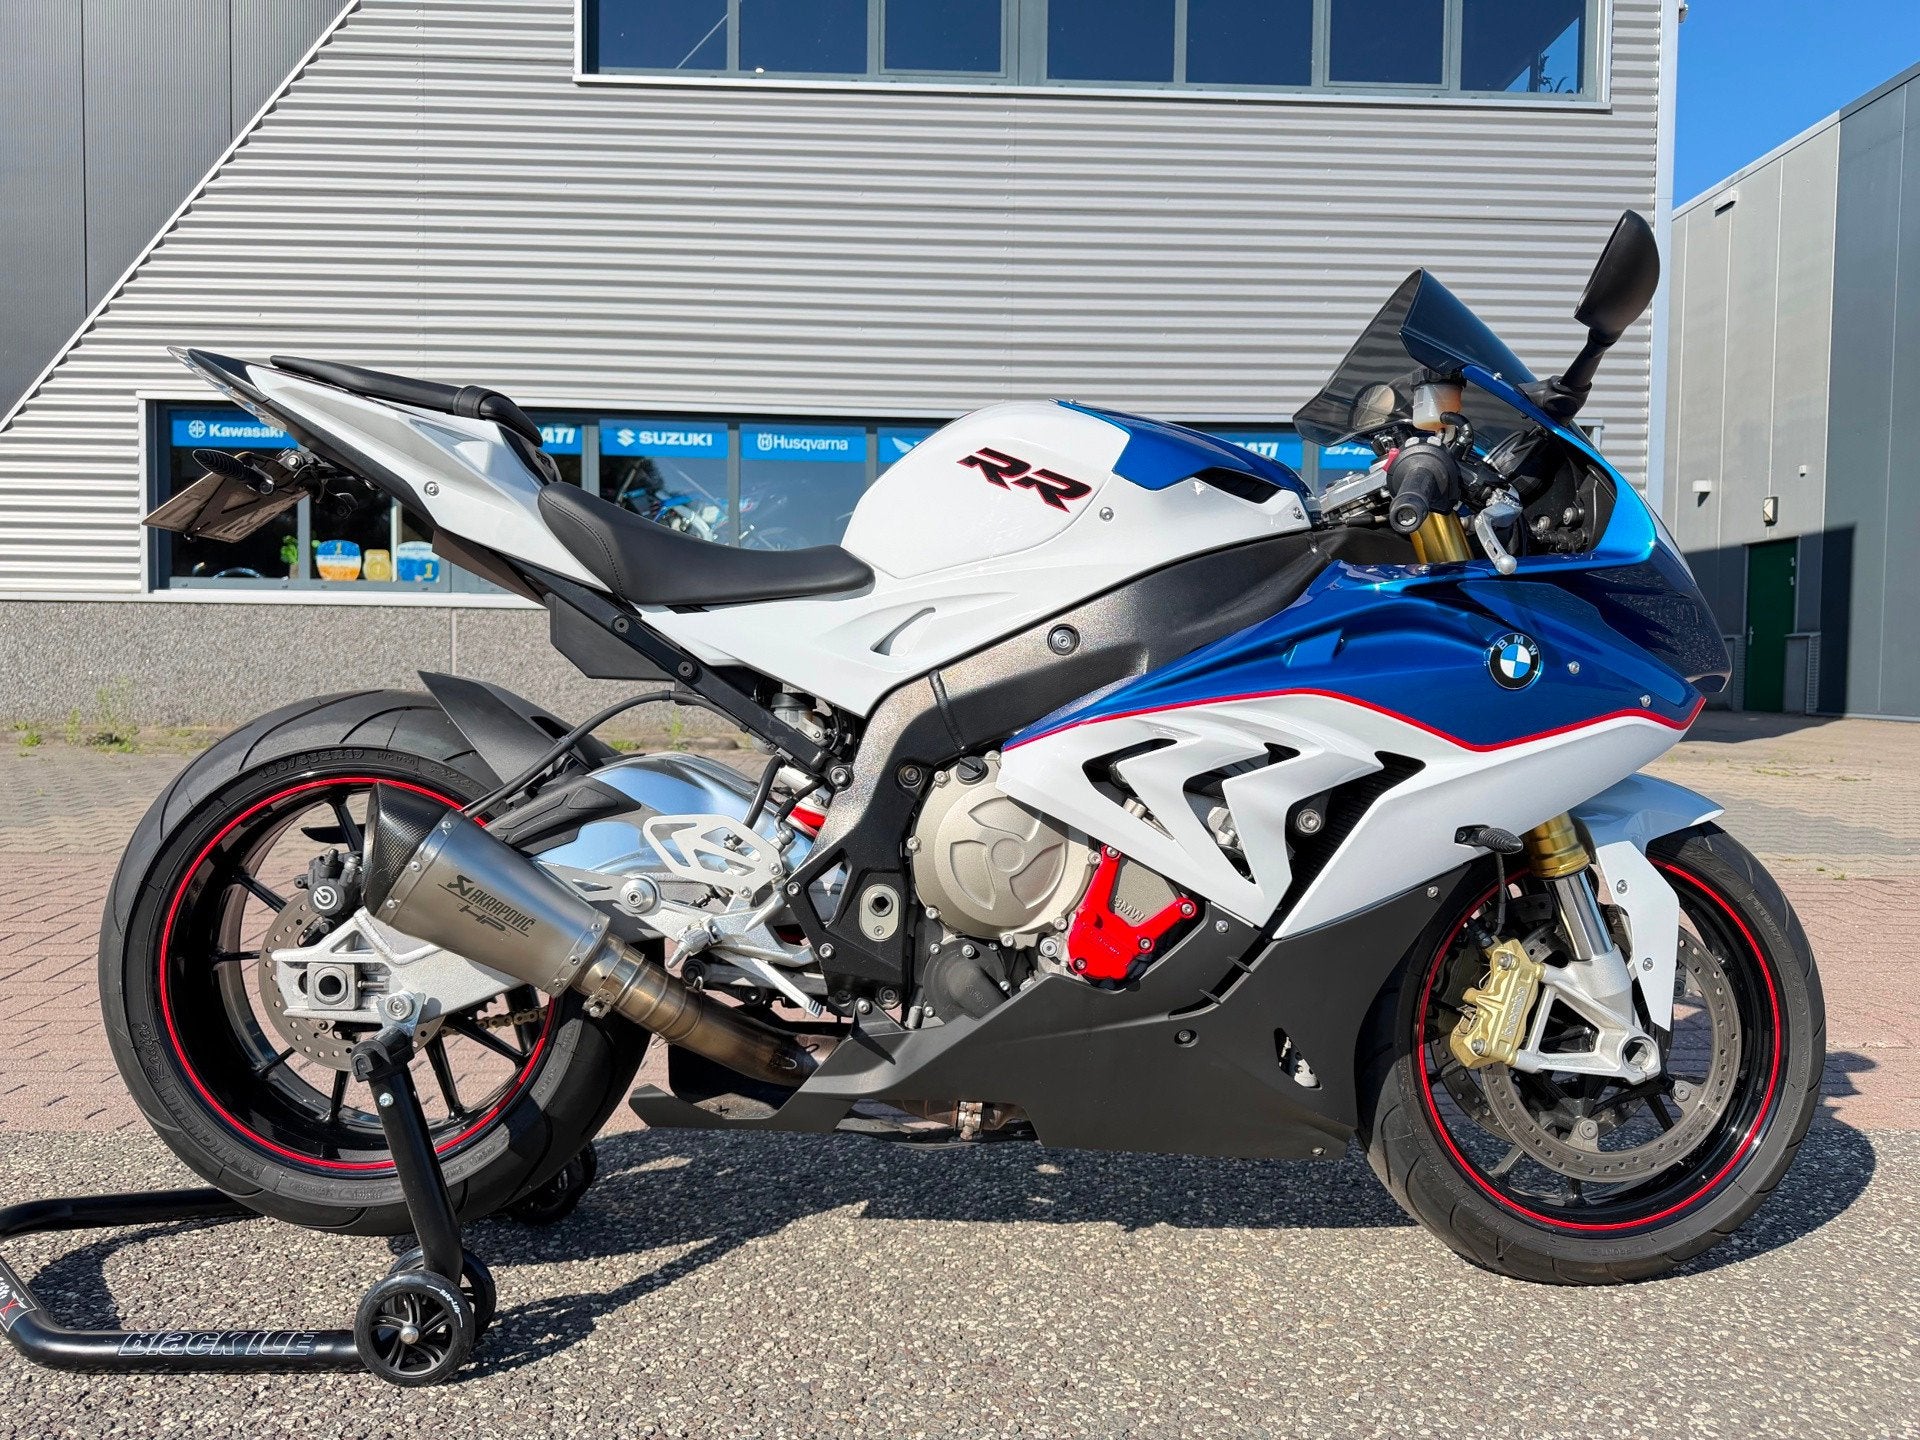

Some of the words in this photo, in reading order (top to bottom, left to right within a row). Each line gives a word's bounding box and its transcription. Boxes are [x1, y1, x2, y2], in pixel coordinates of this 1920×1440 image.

[639, 431, 712, 446] SUZUKI
[774, 434, 848, 452] Husqvarna
[956, 447, 1092, 513] RR
[1497, 635, 1538, 656] BMW
